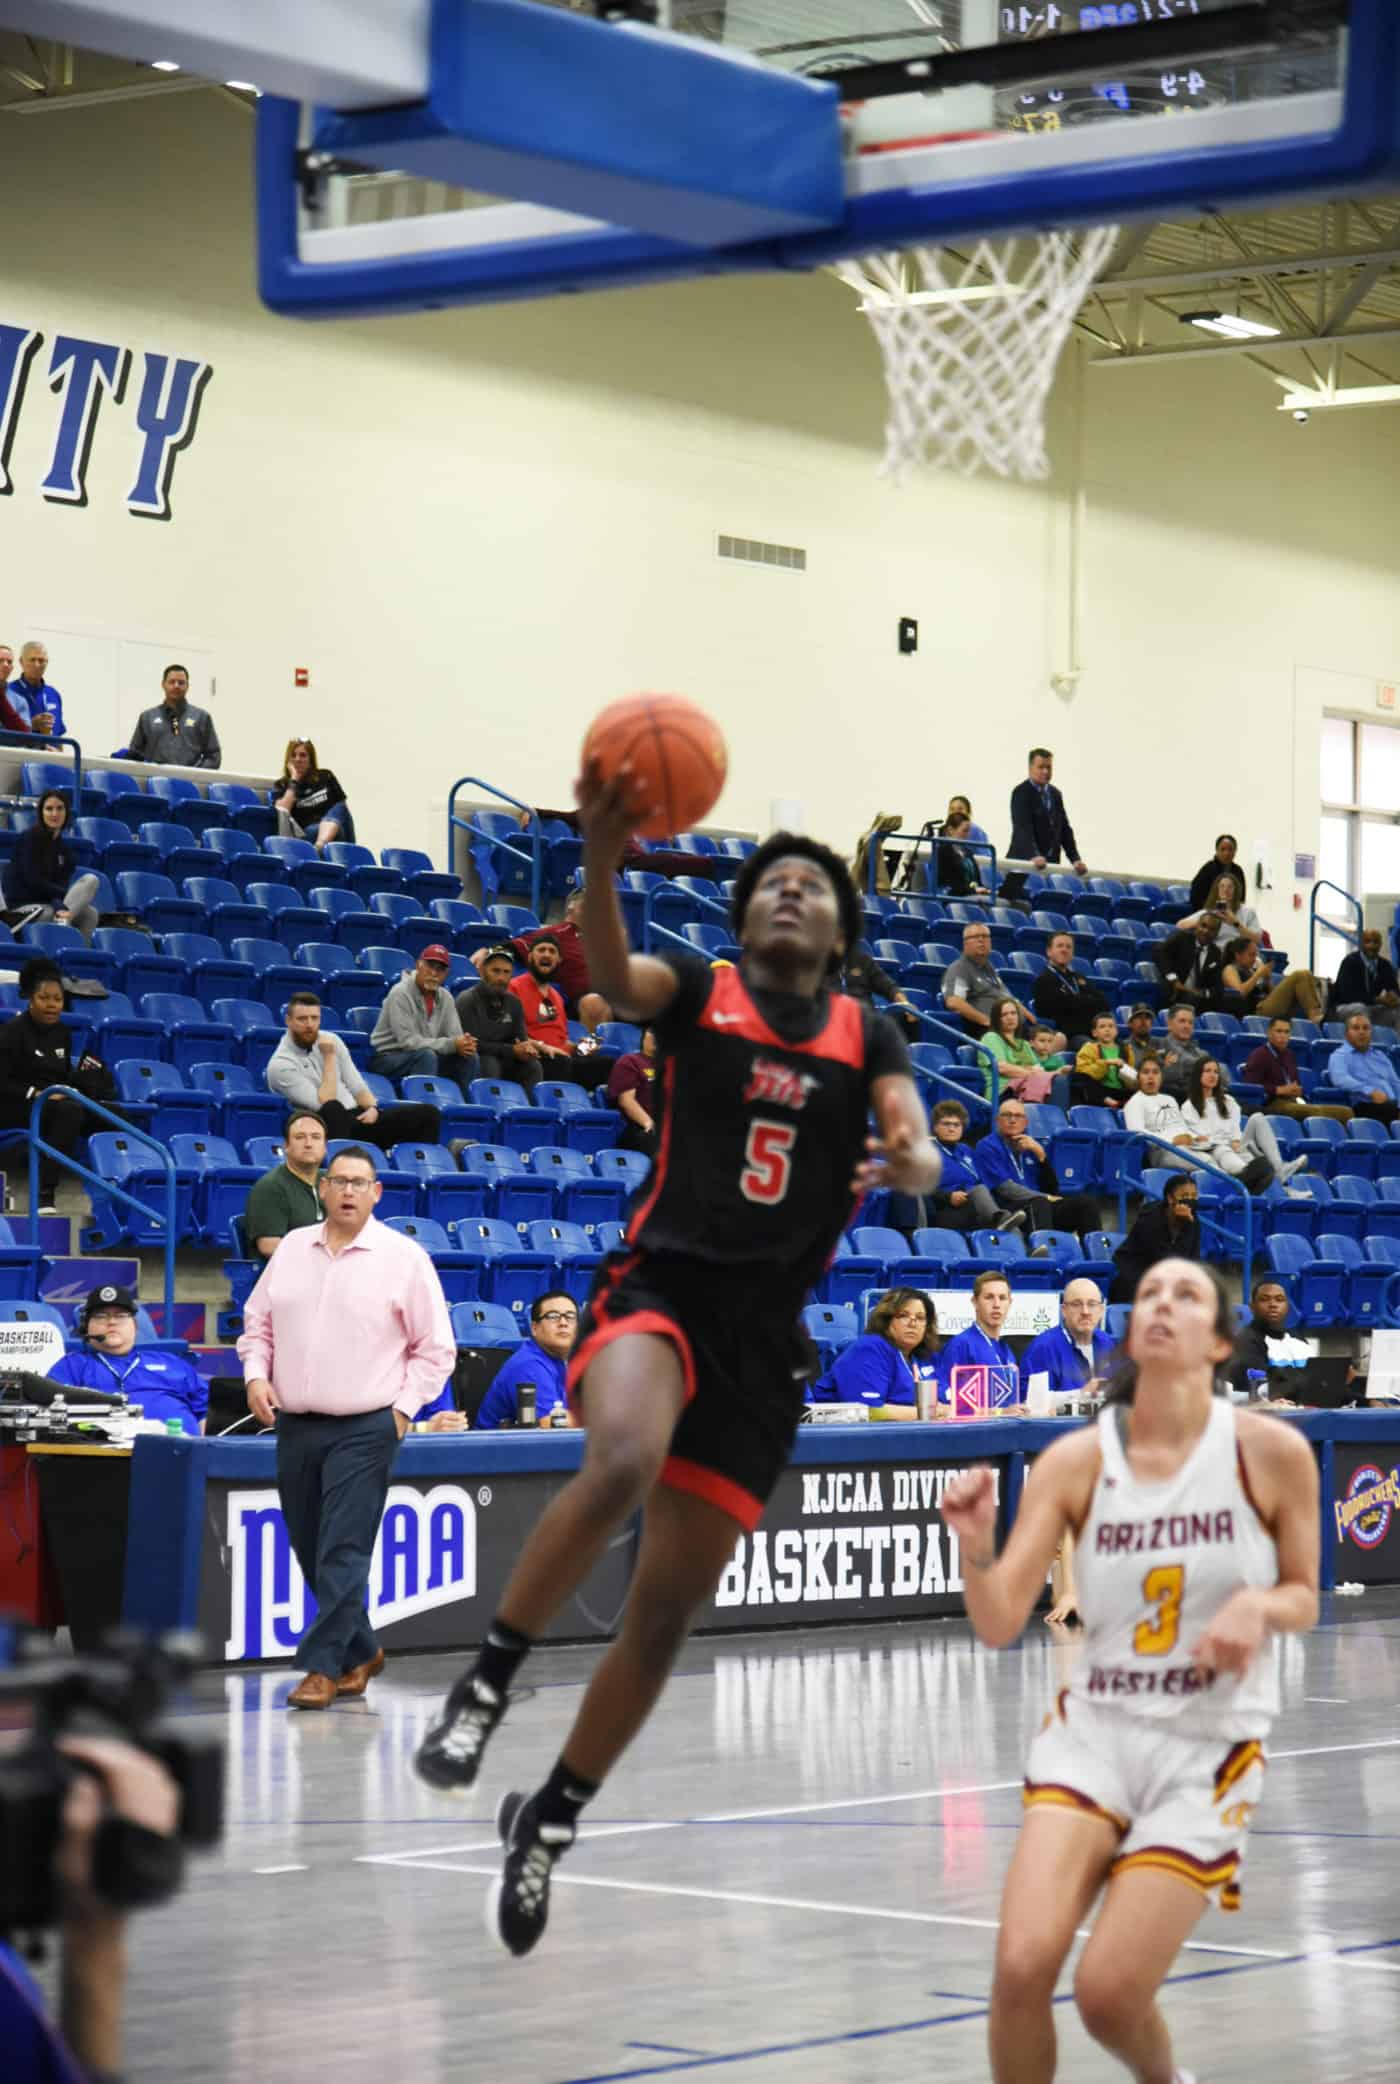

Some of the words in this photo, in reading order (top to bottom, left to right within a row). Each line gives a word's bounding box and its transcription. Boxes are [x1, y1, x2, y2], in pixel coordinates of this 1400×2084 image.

[740, 1117, 798, 1205] 5
[0, 1330, 53, 1345] BASKETBALL
[802, 1473, 883, 1514] NJCAA
[892, 1468, 1000, 1511] DIVI
[1096, 1507, 1235, 1555] ARIZONA
[714, 1522, 965, 1607] BASKETBAL
[1132, 1564, 1185, 1657] 3
